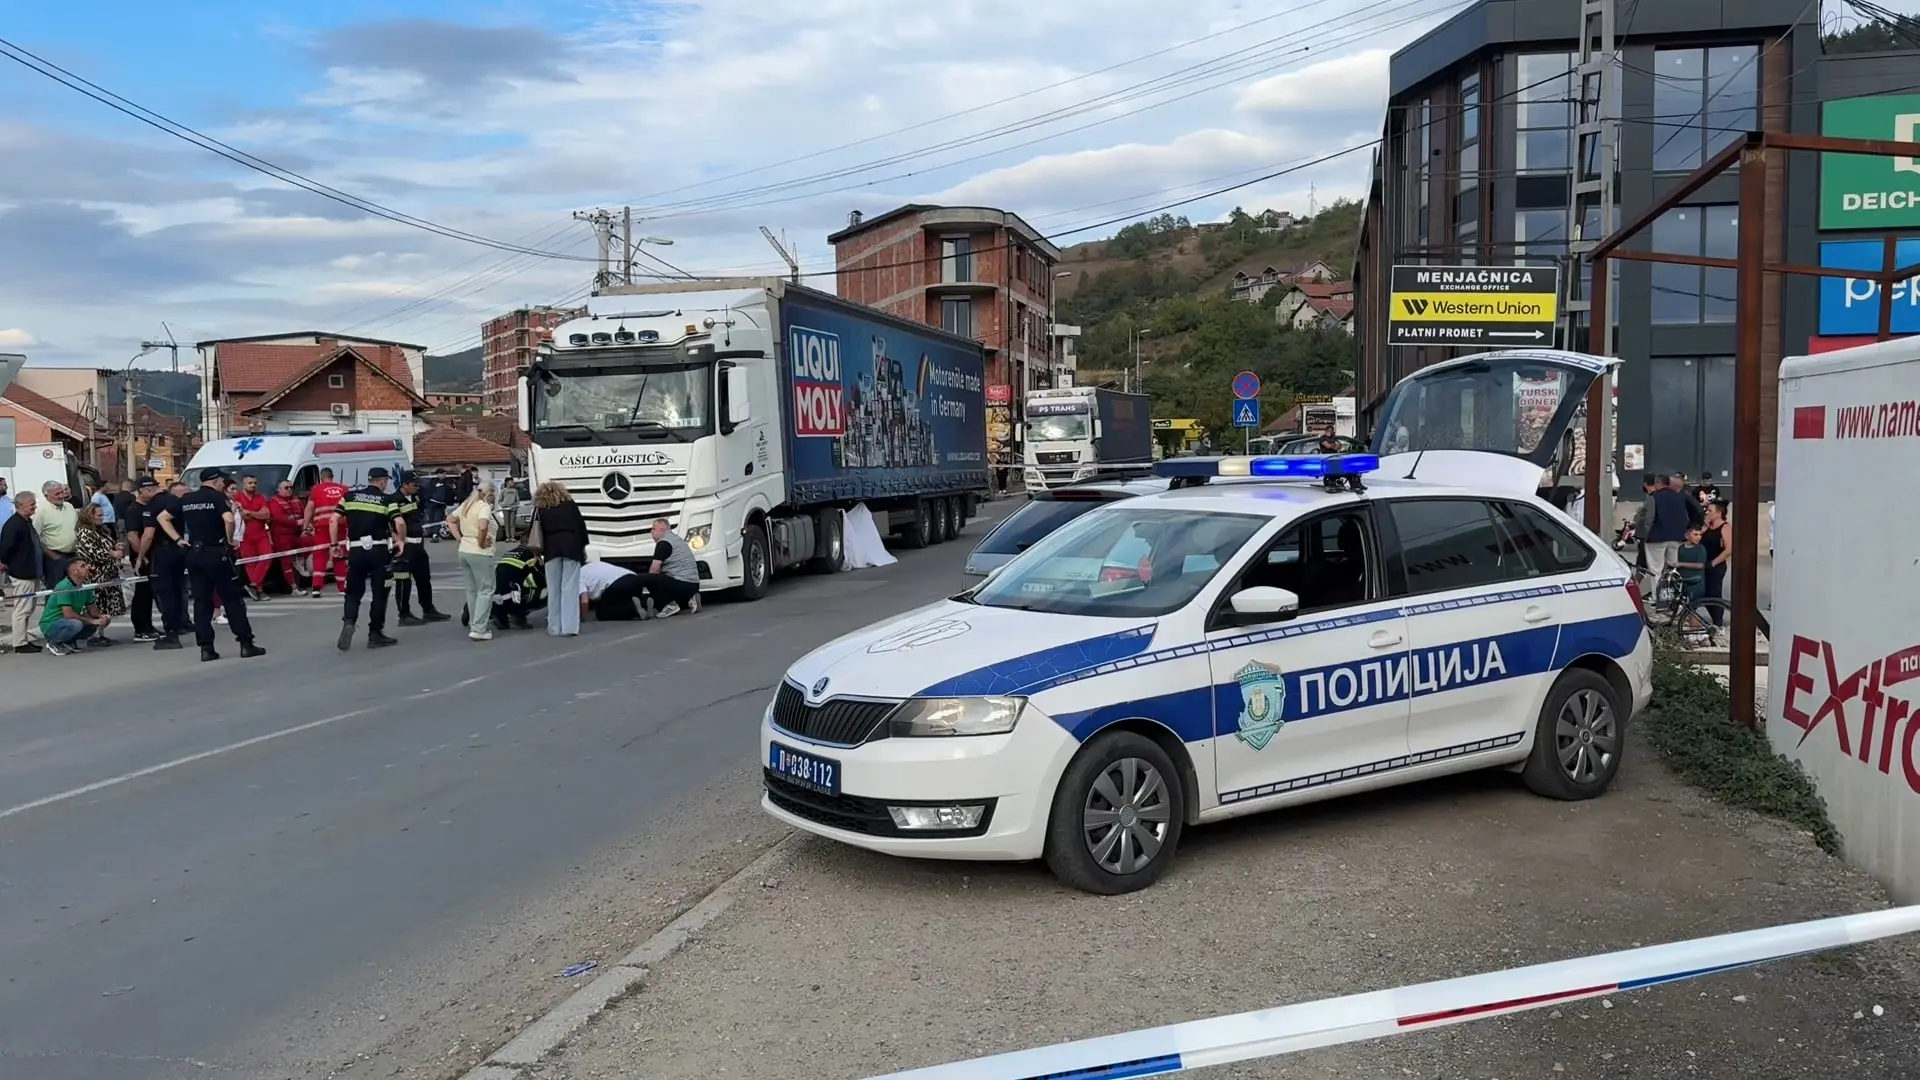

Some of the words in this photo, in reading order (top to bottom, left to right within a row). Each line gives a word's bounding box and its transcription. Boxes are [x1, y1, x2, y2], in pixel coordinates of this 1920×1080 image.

[1417, 270, 1533, 283] MENJAČNICA
[1433, 301, 1494, 315] Western
[1497, 301, 1541, 315] Union
[1398, 328, 1436, 338] PLATNI
[1439, 328, 1483, 338] PROMET
[793, 333, 840, 382] LIQUI
[928, 361, 965, 390] Motorenöle
[965, 369, 981, 392] made
[1519, 388, 1558, 397] TURSKI
[796, 386, 842, 431] MOLY
[931, 394, 938, 416] in
[939, 394, 966, 423] Germany
[1039, 405, 1048, 413] PS
[1050, 404, 1076, 412] TRANS
[597, 454, 655, 465] LOGISTIC
[1900, 654, 1920, 673] na
[1300, 640, 1507, 714] ПОЛИЦИЈА
